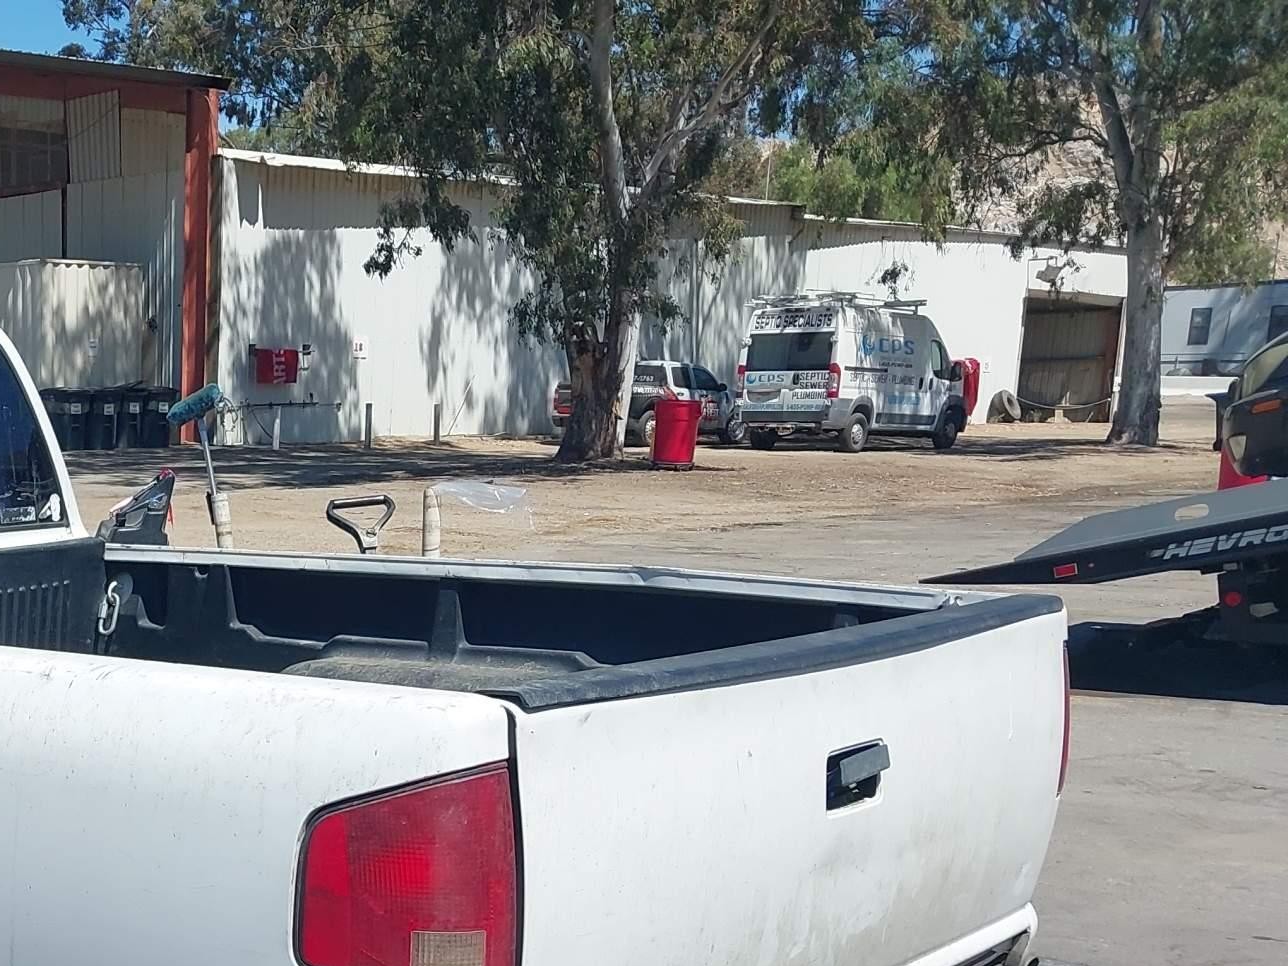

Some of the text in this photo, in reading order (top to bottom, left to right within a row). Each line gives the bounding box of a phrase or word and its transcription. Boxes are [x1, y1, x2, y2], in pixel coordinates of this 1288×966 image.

[754, 313, 833, 329] SEPTIC SPECIALISTS
[879, 337, 915, 355] CPS
[758, 373, 785, 383] CPS
[799, 372, 830, 381] SEPTIC
[799, 381, 828, 389] SEWER
